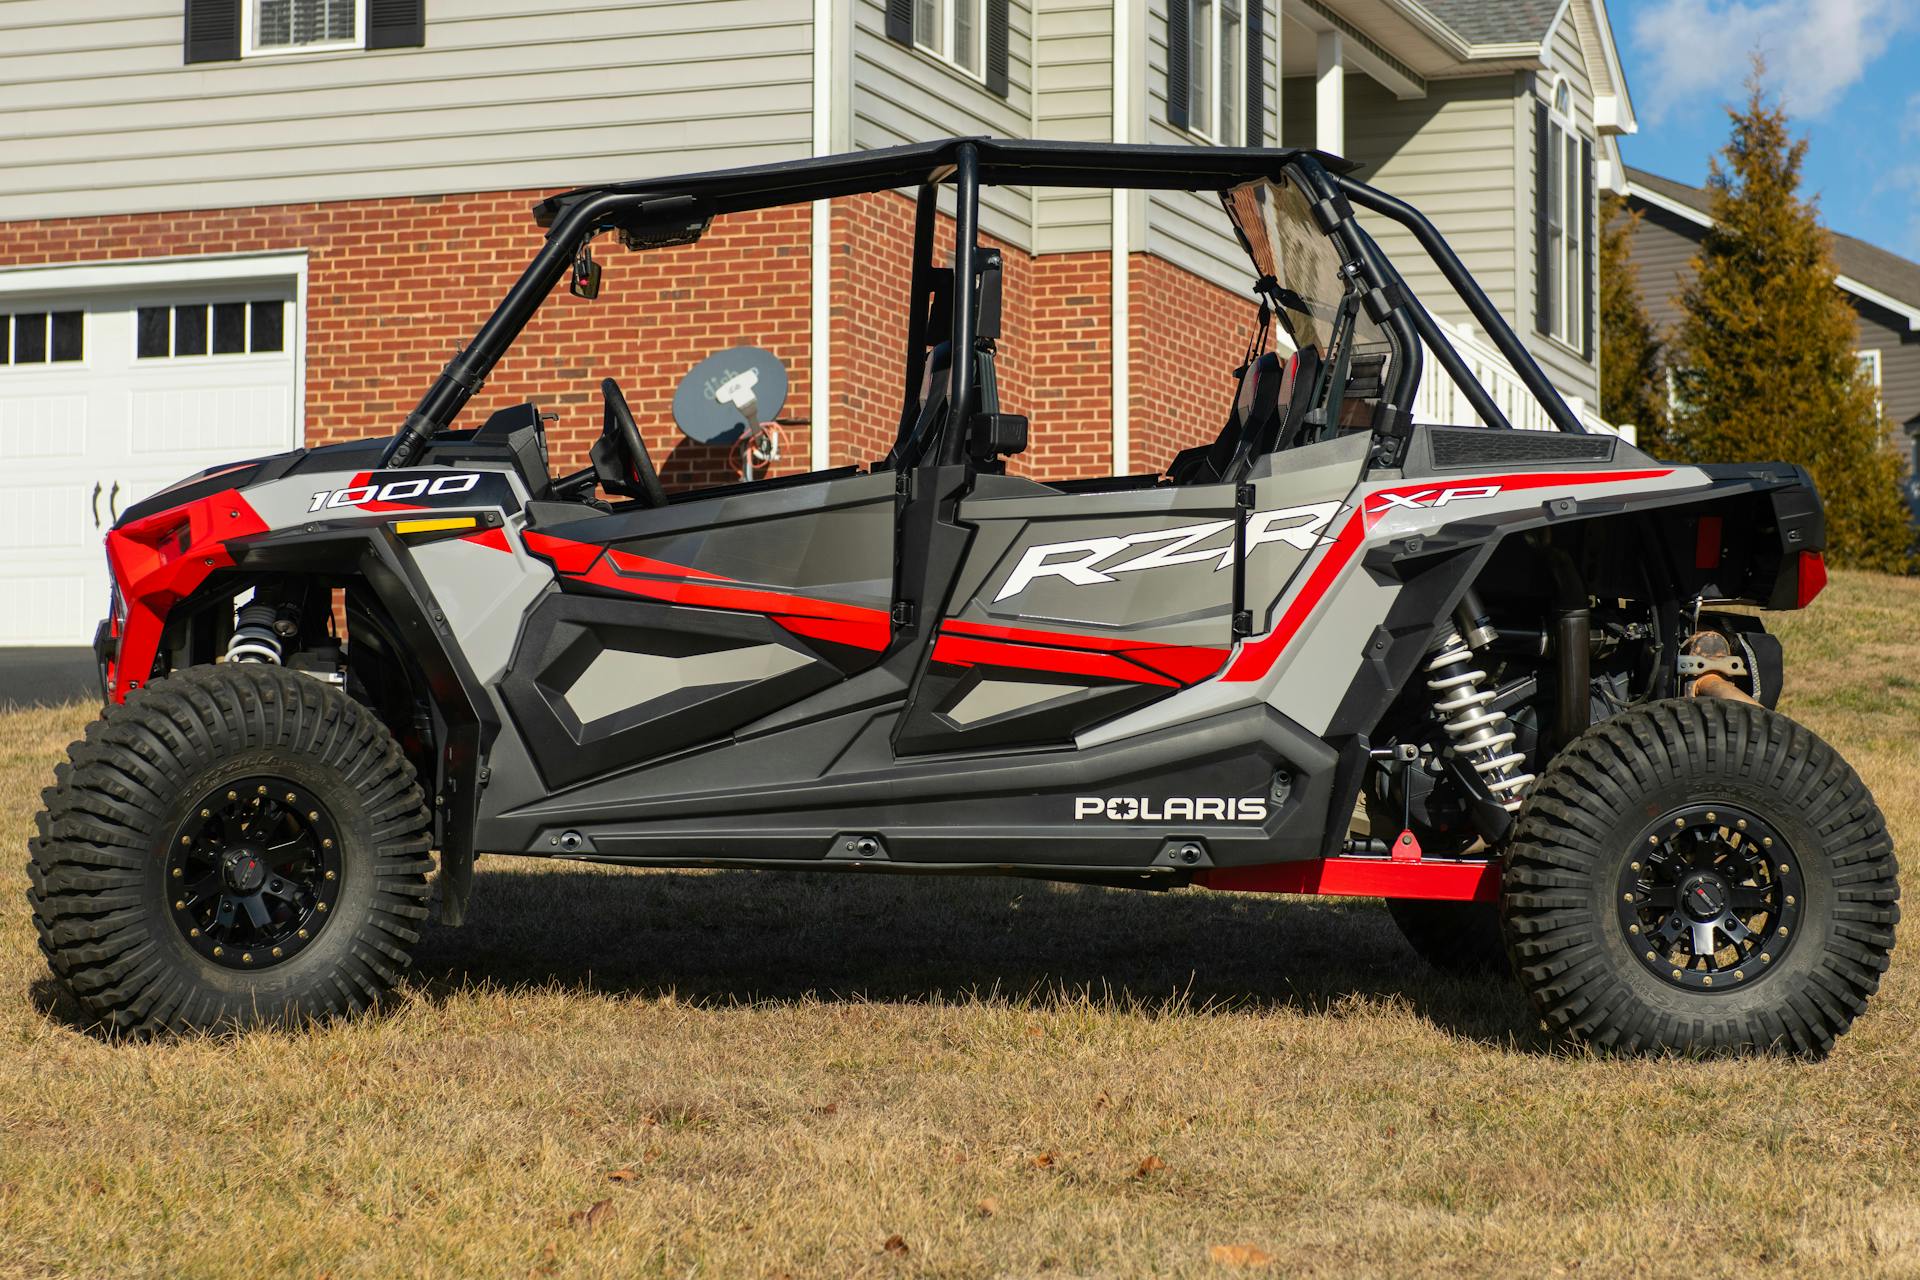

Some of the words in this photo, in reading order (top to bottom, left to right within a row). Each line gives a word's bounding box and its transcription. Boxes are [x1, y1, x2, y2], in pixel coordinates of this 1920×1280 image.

[307, 473, 480, 513] 1000
[1366, 485, 1503, 513] XP
[991, 499, 1352, 605] RZR
[1074, 797, 1267, 821] POLARIS
